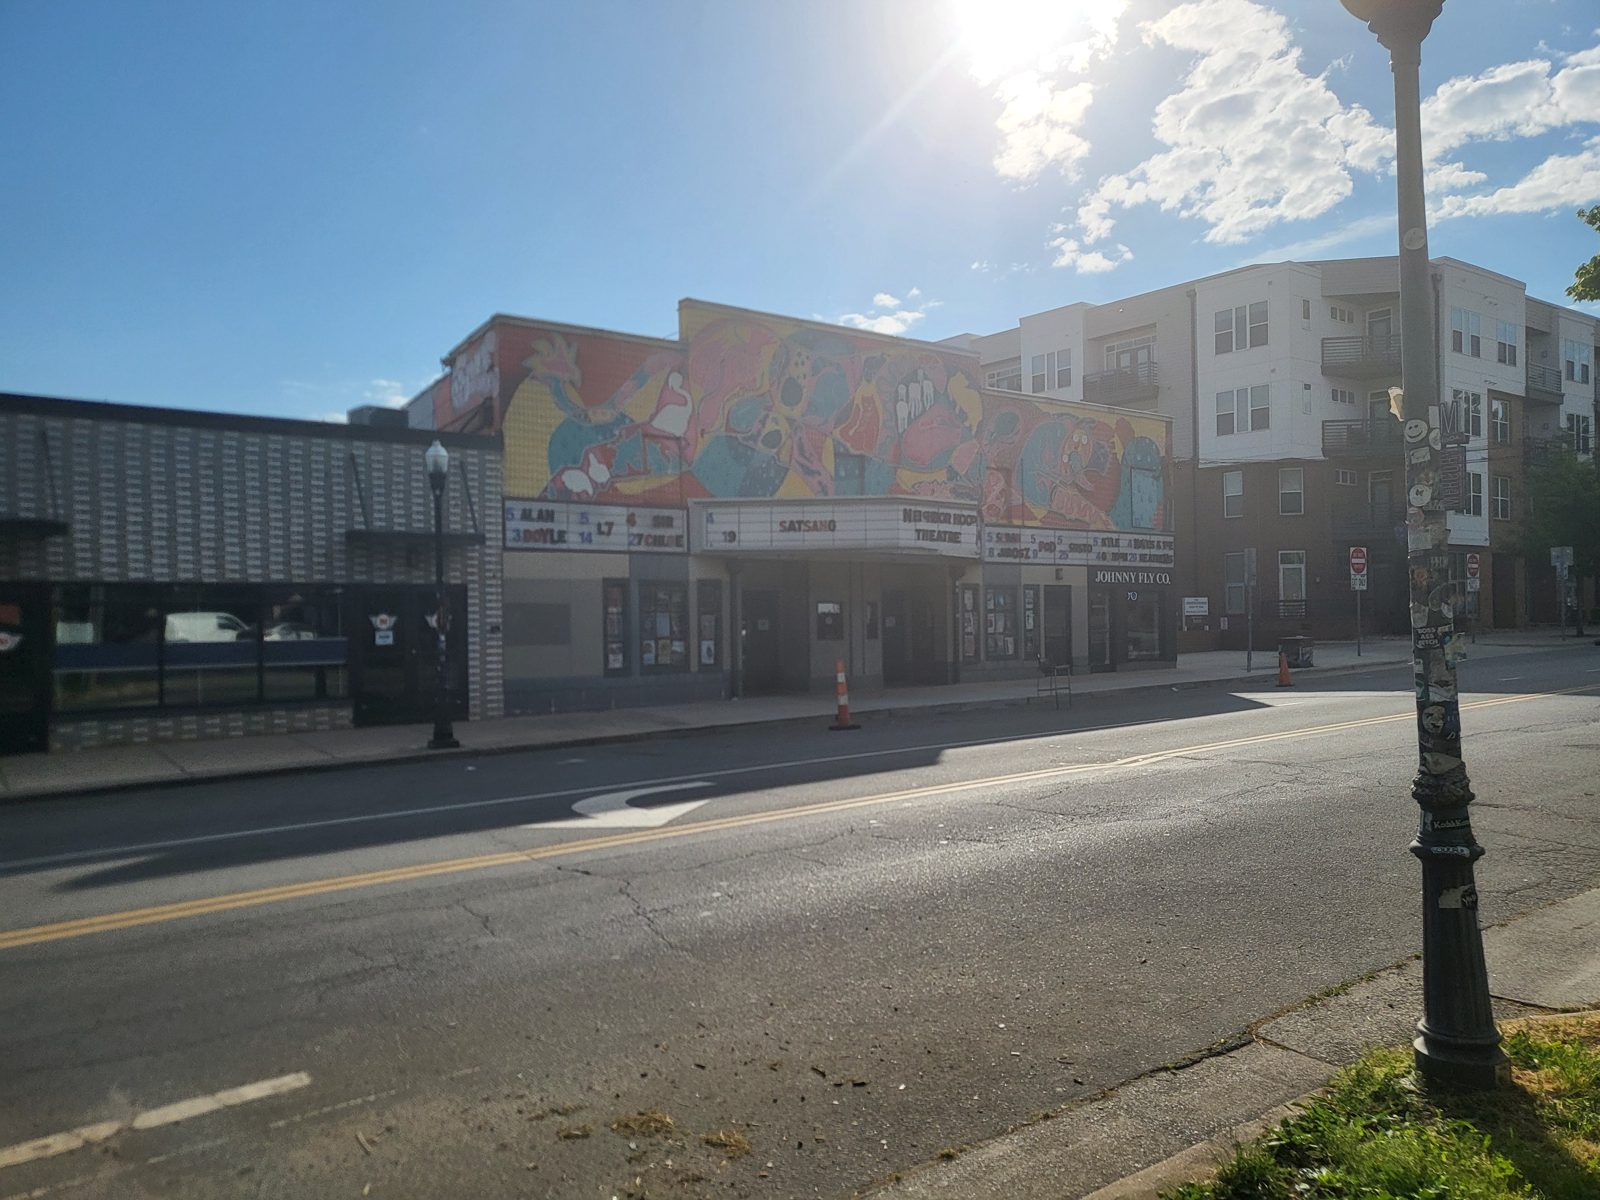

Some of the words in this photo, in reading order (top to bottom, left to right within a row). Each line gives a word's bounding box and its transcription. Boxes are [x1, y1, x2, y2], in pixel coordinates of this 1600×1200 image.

[520, 507, 555, 523] ALAN
[523, 528, 567, 544] DOYLE
[721, 530, 737, 543] 19
[1095, 570, 1137, 584] JOHNNY
[1138, 572, 1155, 584] FLY
[1156, 573, 1172, 585] CO.
